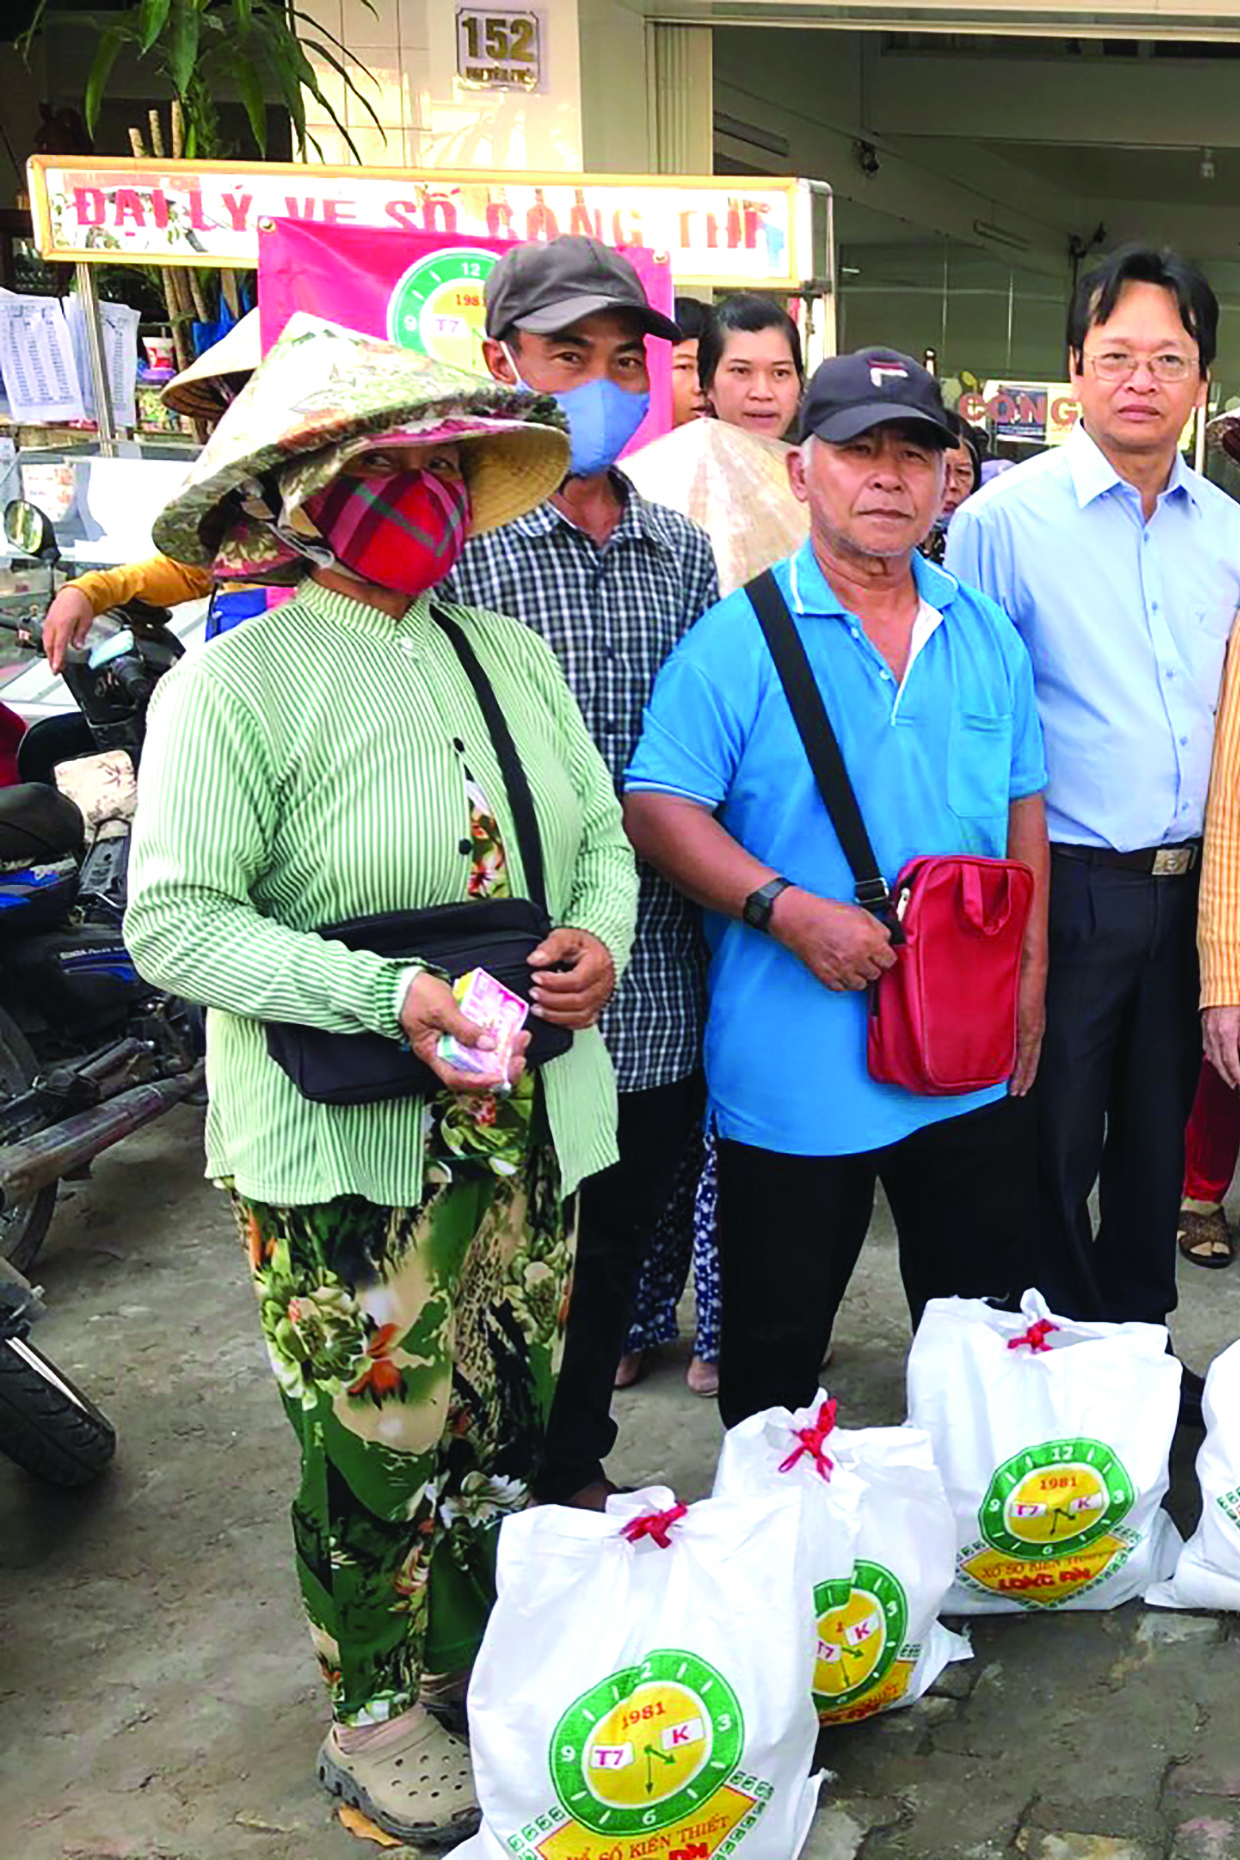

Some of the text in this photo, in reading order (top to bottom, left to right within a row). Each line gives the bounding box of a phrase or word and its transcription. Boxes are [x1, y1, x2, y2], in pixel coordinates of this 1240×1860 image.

[462, 17, 534, 62] 152
[66, 187, 169, 236] ĐẠI
[190, 184, 252, 232] LÝ
[461, 262, 481, 277] 12
[456, 293, 487, 307] 198
[404, 315, 417, 331] 9
[435, 318, 459, 333] T7
[1052, 1446, 1074, 1461] 12
[1040, 1476, 1078, 1491] 1981
[1078, 1498, 1091, 1509] K
[1114, 1490, 1125, 1505] 3
[989, 1500, 1001, 1512] 9
[1042, 1545, 1054, 1555] 6
[998, 1574, 1055, 1591] LONG
[854, 1621, 871, 1640] K
[621, 1701, 667, 1731] 1981
[717, 1713, 732, 1732] 3
[672, 1725, 690, 1745] K
[561, 1745, 576, 1763] 9
[595, 1749, 625, 1767] T7
[642, 1809, 657, 1825] 6
[629, 1834, 672, 1858] KIẾN
[677, 1813, 731, 1848] THIẾT
